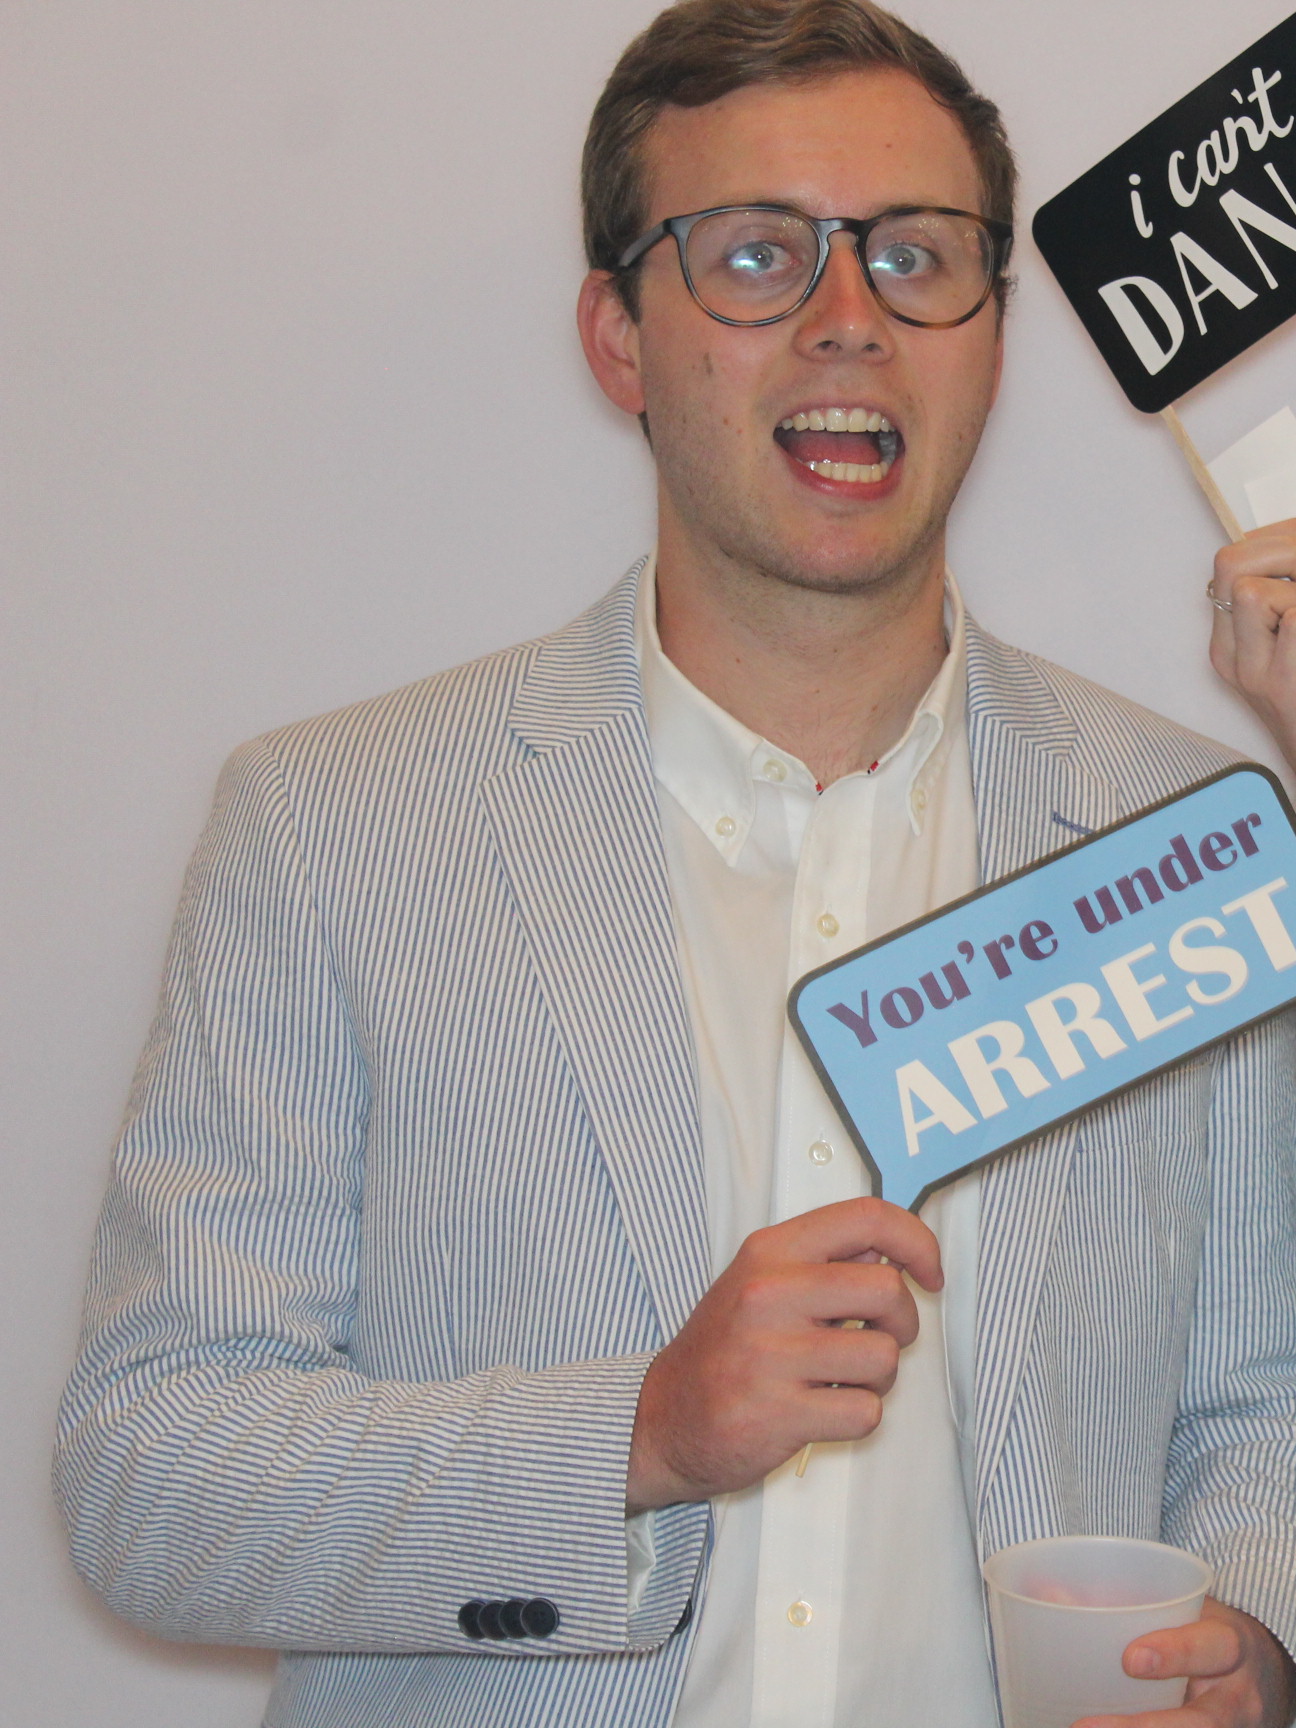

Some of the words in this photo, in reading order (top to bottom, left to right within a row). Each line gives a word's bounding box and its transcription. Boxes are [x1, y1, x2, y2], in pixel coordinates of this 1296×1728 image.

[1128, 173, 1154, 239] i
[1167, 66, 1295, 208] can't
[825, 919, 1060, 1049] You're
[1071, 812, 1263, 934] under
